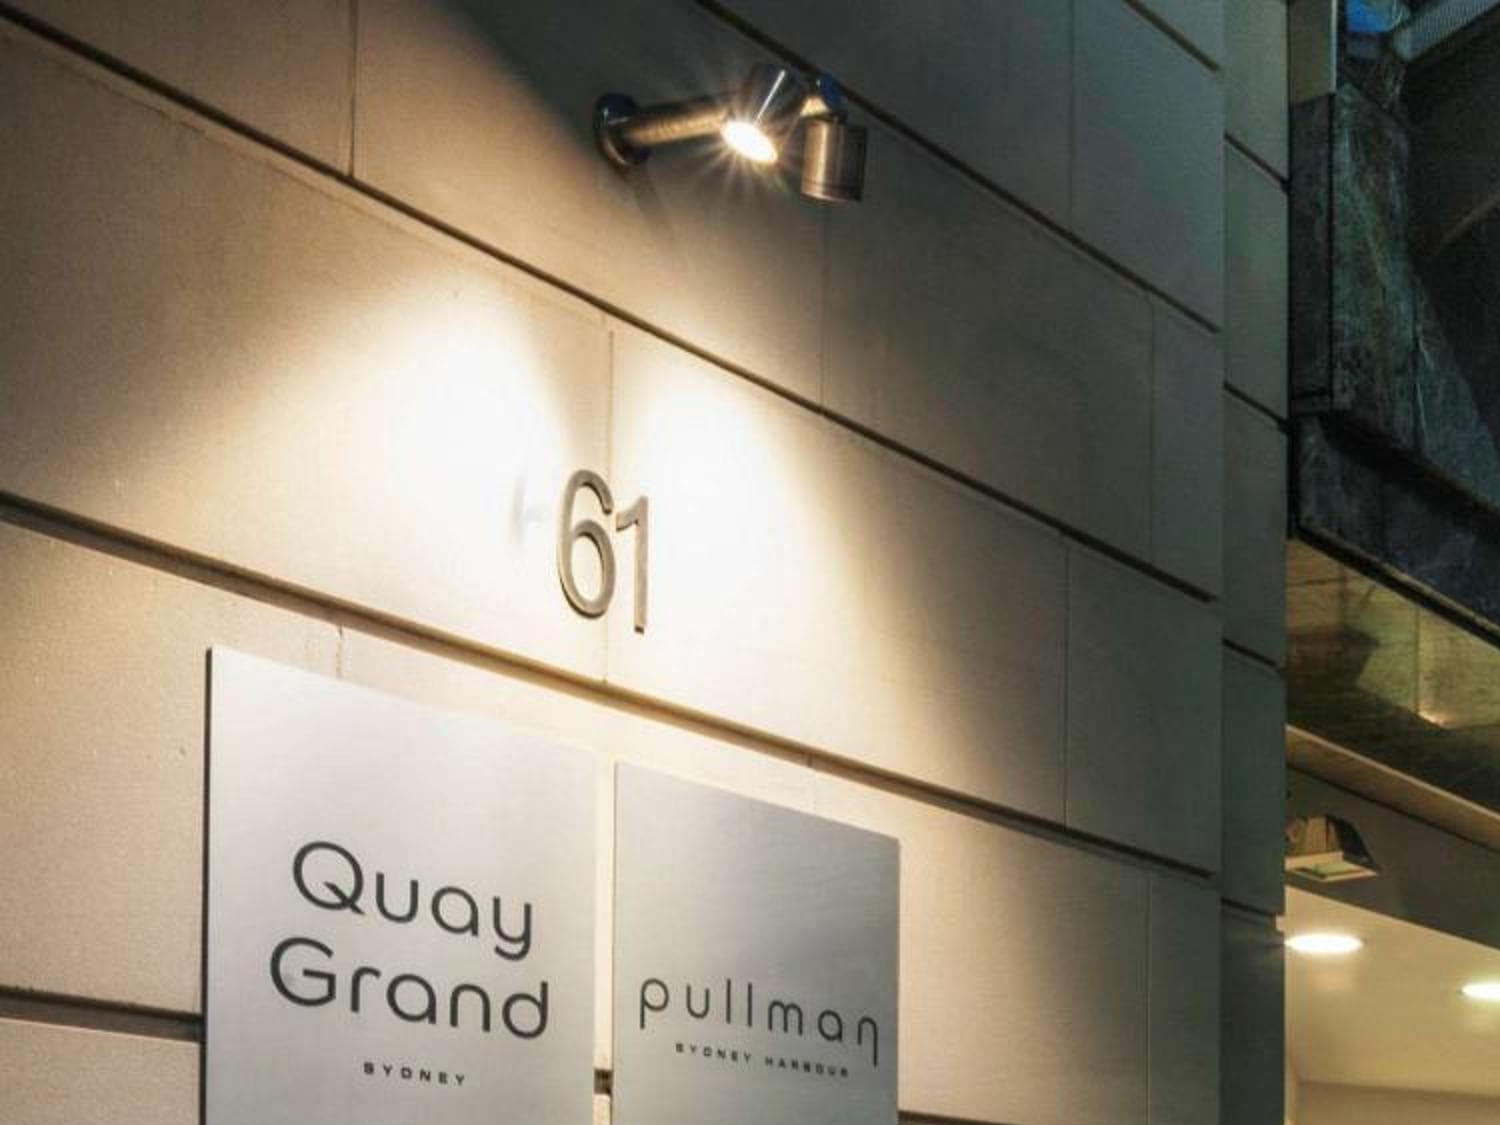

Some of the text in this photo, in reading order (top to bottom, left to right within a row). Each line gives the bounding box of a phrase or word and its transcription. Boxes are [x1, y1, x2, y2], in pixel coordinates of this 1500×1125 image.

[557, 469, 649, 634] 61
[292, 841, 532, 961] Quay
[269, 936, 549, 1040] Grand
[639, 977, 878, 1068] pullman
[363, 1061, 465, 1086] SYDNEY
[675, 1042, 849, 1078] SYDNEY HARBOUR
